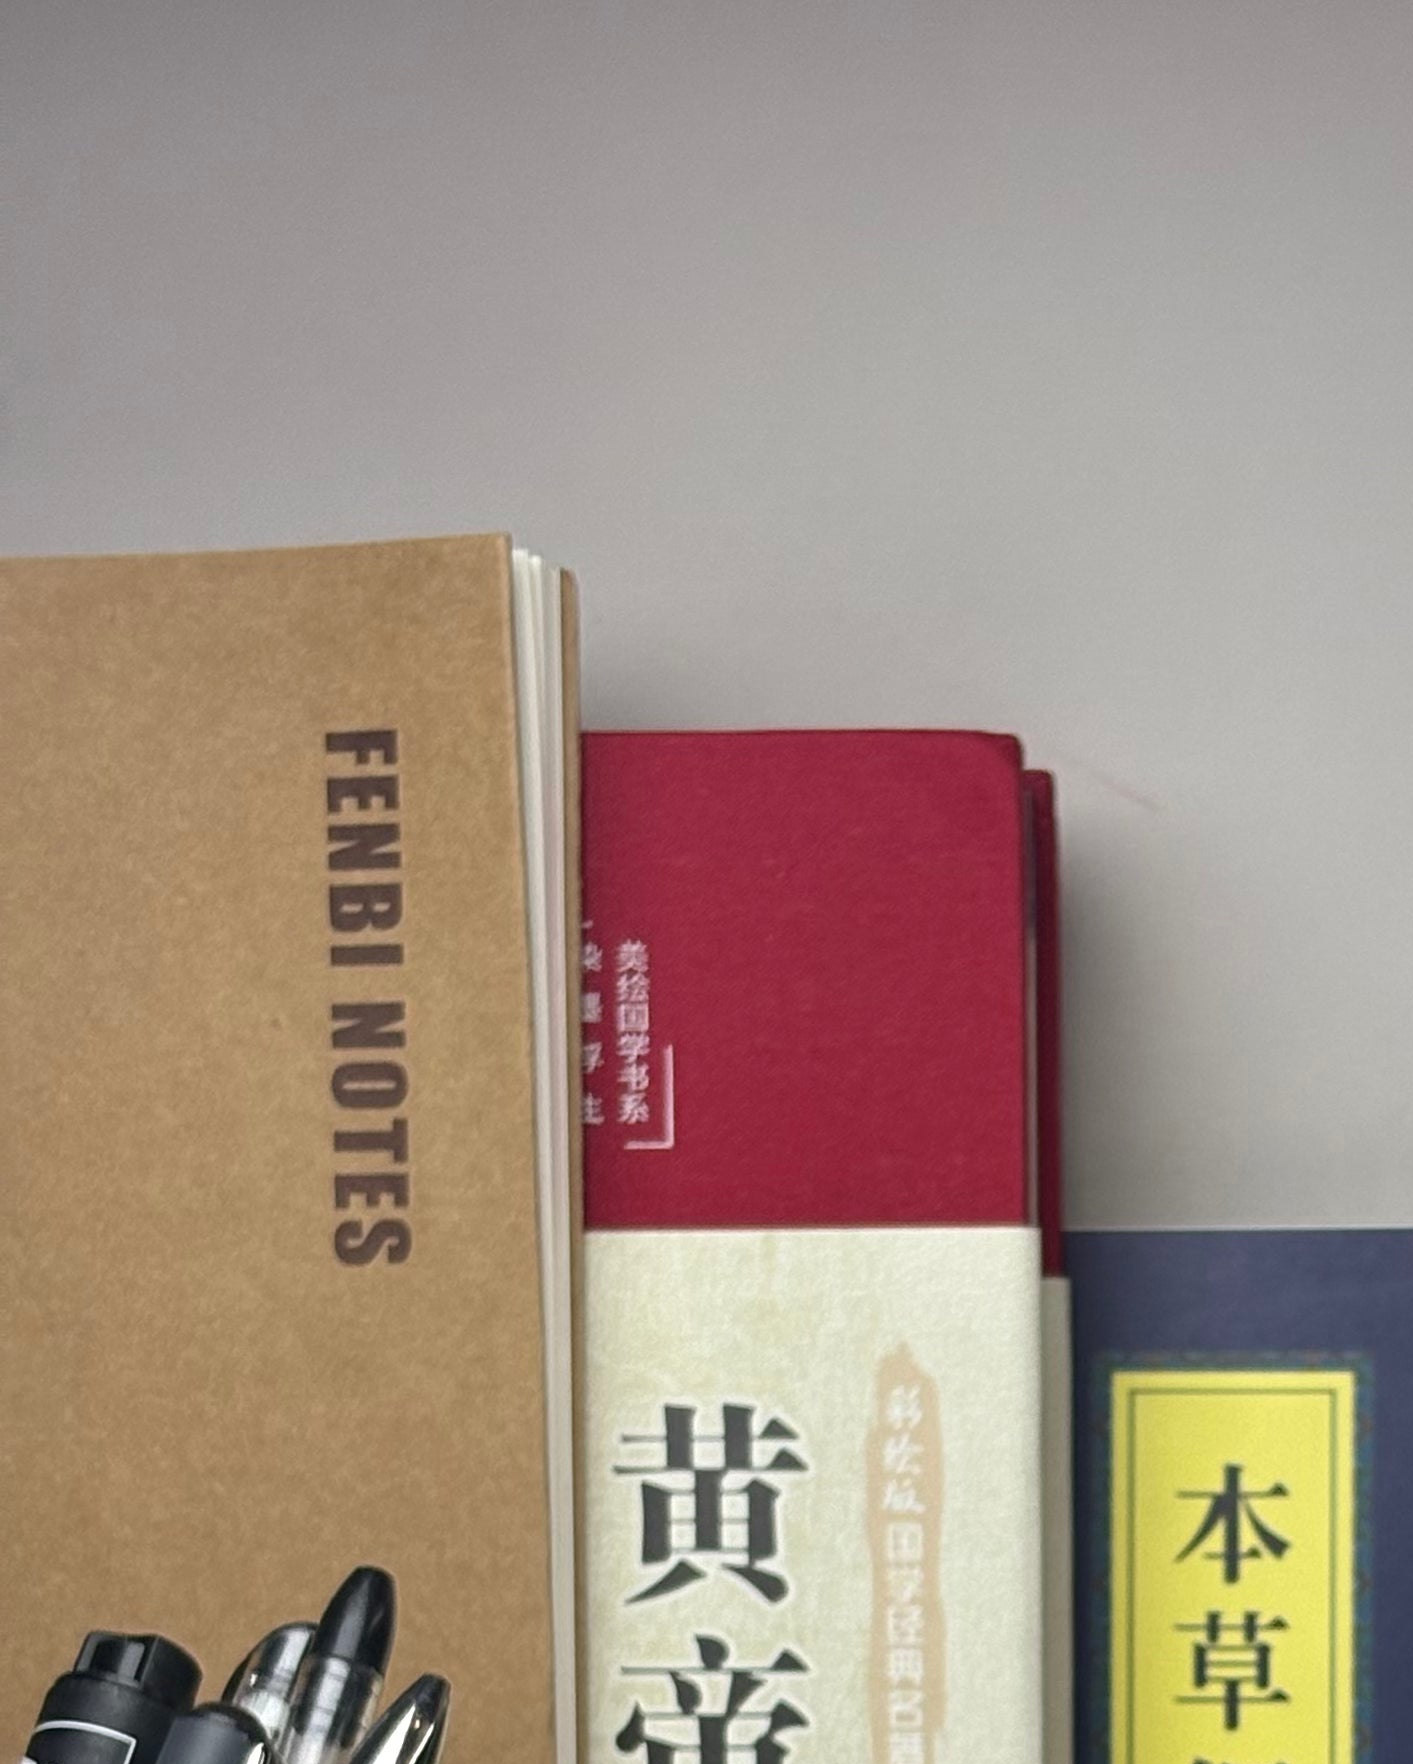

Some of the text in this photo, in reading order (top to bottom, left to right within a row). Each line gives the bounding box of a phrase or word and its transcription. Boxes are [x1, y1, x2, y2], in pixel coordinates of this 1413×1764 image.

[325, 729, 412, 1267] FENBI NOTES
[615, 939, 650, 1125] 美绘国学书系
